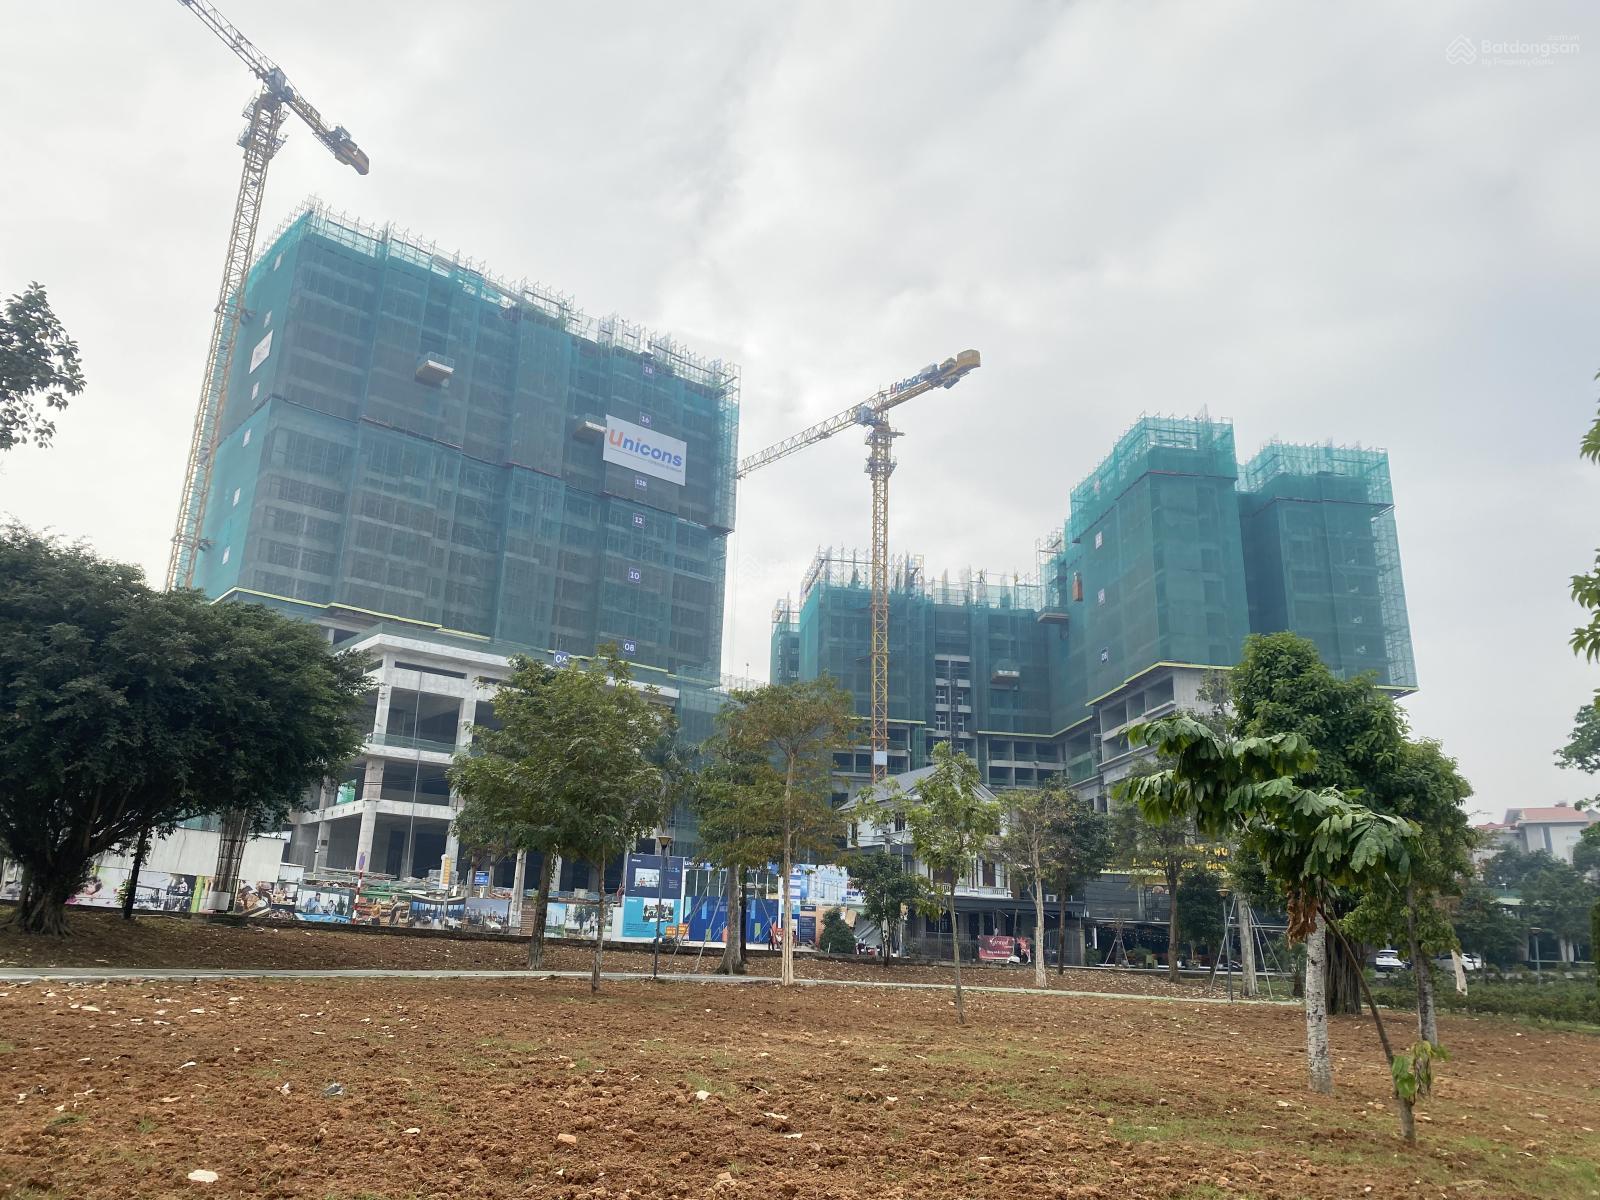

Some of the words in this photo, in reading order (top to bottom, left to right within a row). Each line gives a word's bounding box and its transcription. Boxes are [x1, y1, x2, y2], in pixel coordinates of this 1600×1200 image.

[609, 430, 682, 467] Unicons
[634, 516, 643, 525] 12
[629, 571, 640, 580] 10
[555, 654, 568, 664] 06
